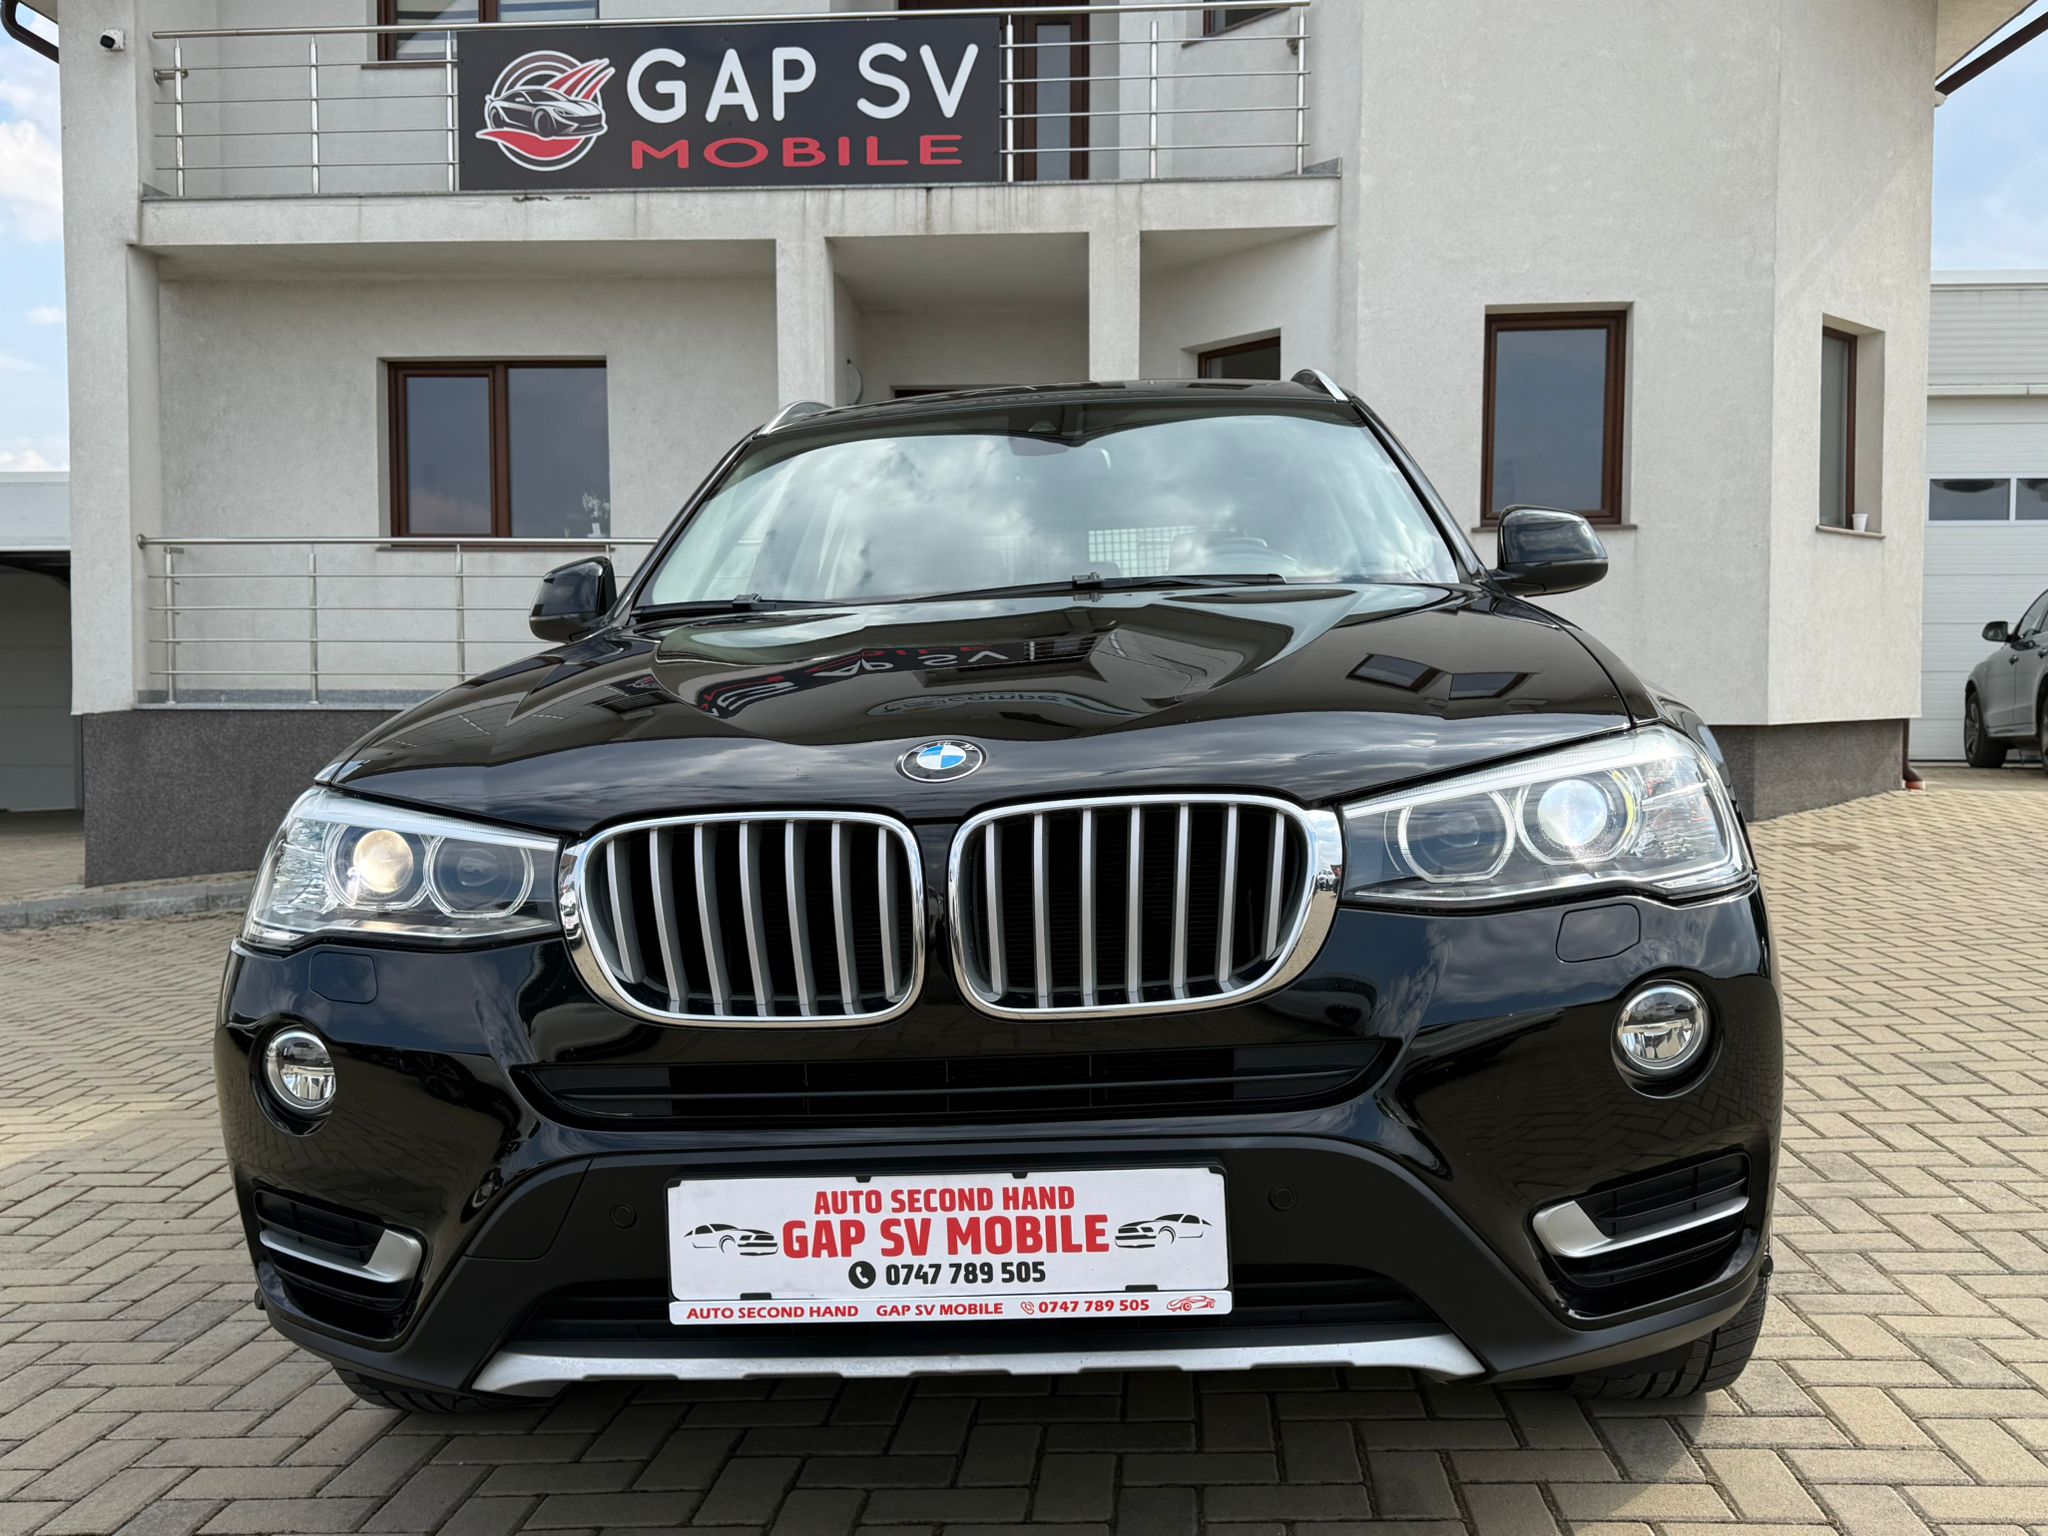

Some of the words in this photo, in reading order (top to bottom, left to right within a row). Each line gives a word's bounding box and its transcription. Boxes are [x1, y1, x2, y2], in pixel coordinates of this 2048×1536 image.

[626, 47, 817, 124] GAP
[856, 42, 979, 119] SV
[631, 134, 962, 170] MOBILE
[814, 1189, 883, 1216] AUTO
[890, 1187, 994, 1215] SECOND
[1002, 1185, 1076, 1212] HAND
[782, 1218, 867, 1260] GAP
[879, 1217, 933, 1258] SV
[945, 1213, 1111, 1257] MOBILE
[885, 1263, 942, 1286] 0747
[948, 1262, 994, 1284] 789
[1001, 1261, 1046, 1283] 505
[687, 1307, 735, 1321] AUTO
[738, 1305, 807, 1320] SECOND
[808, 1304, 860, 1319] HAND
[875, 1304, 912, 1318] GAP
[915, 1304, 936, 1317] SV
[938, 1302, 1004, 1317] MOBILE
[1038, 1299, 1080, 1314] 0747
[1084, 1298, 1116, 1313] 789
[1119, 1298, 1151, 1313] 505
